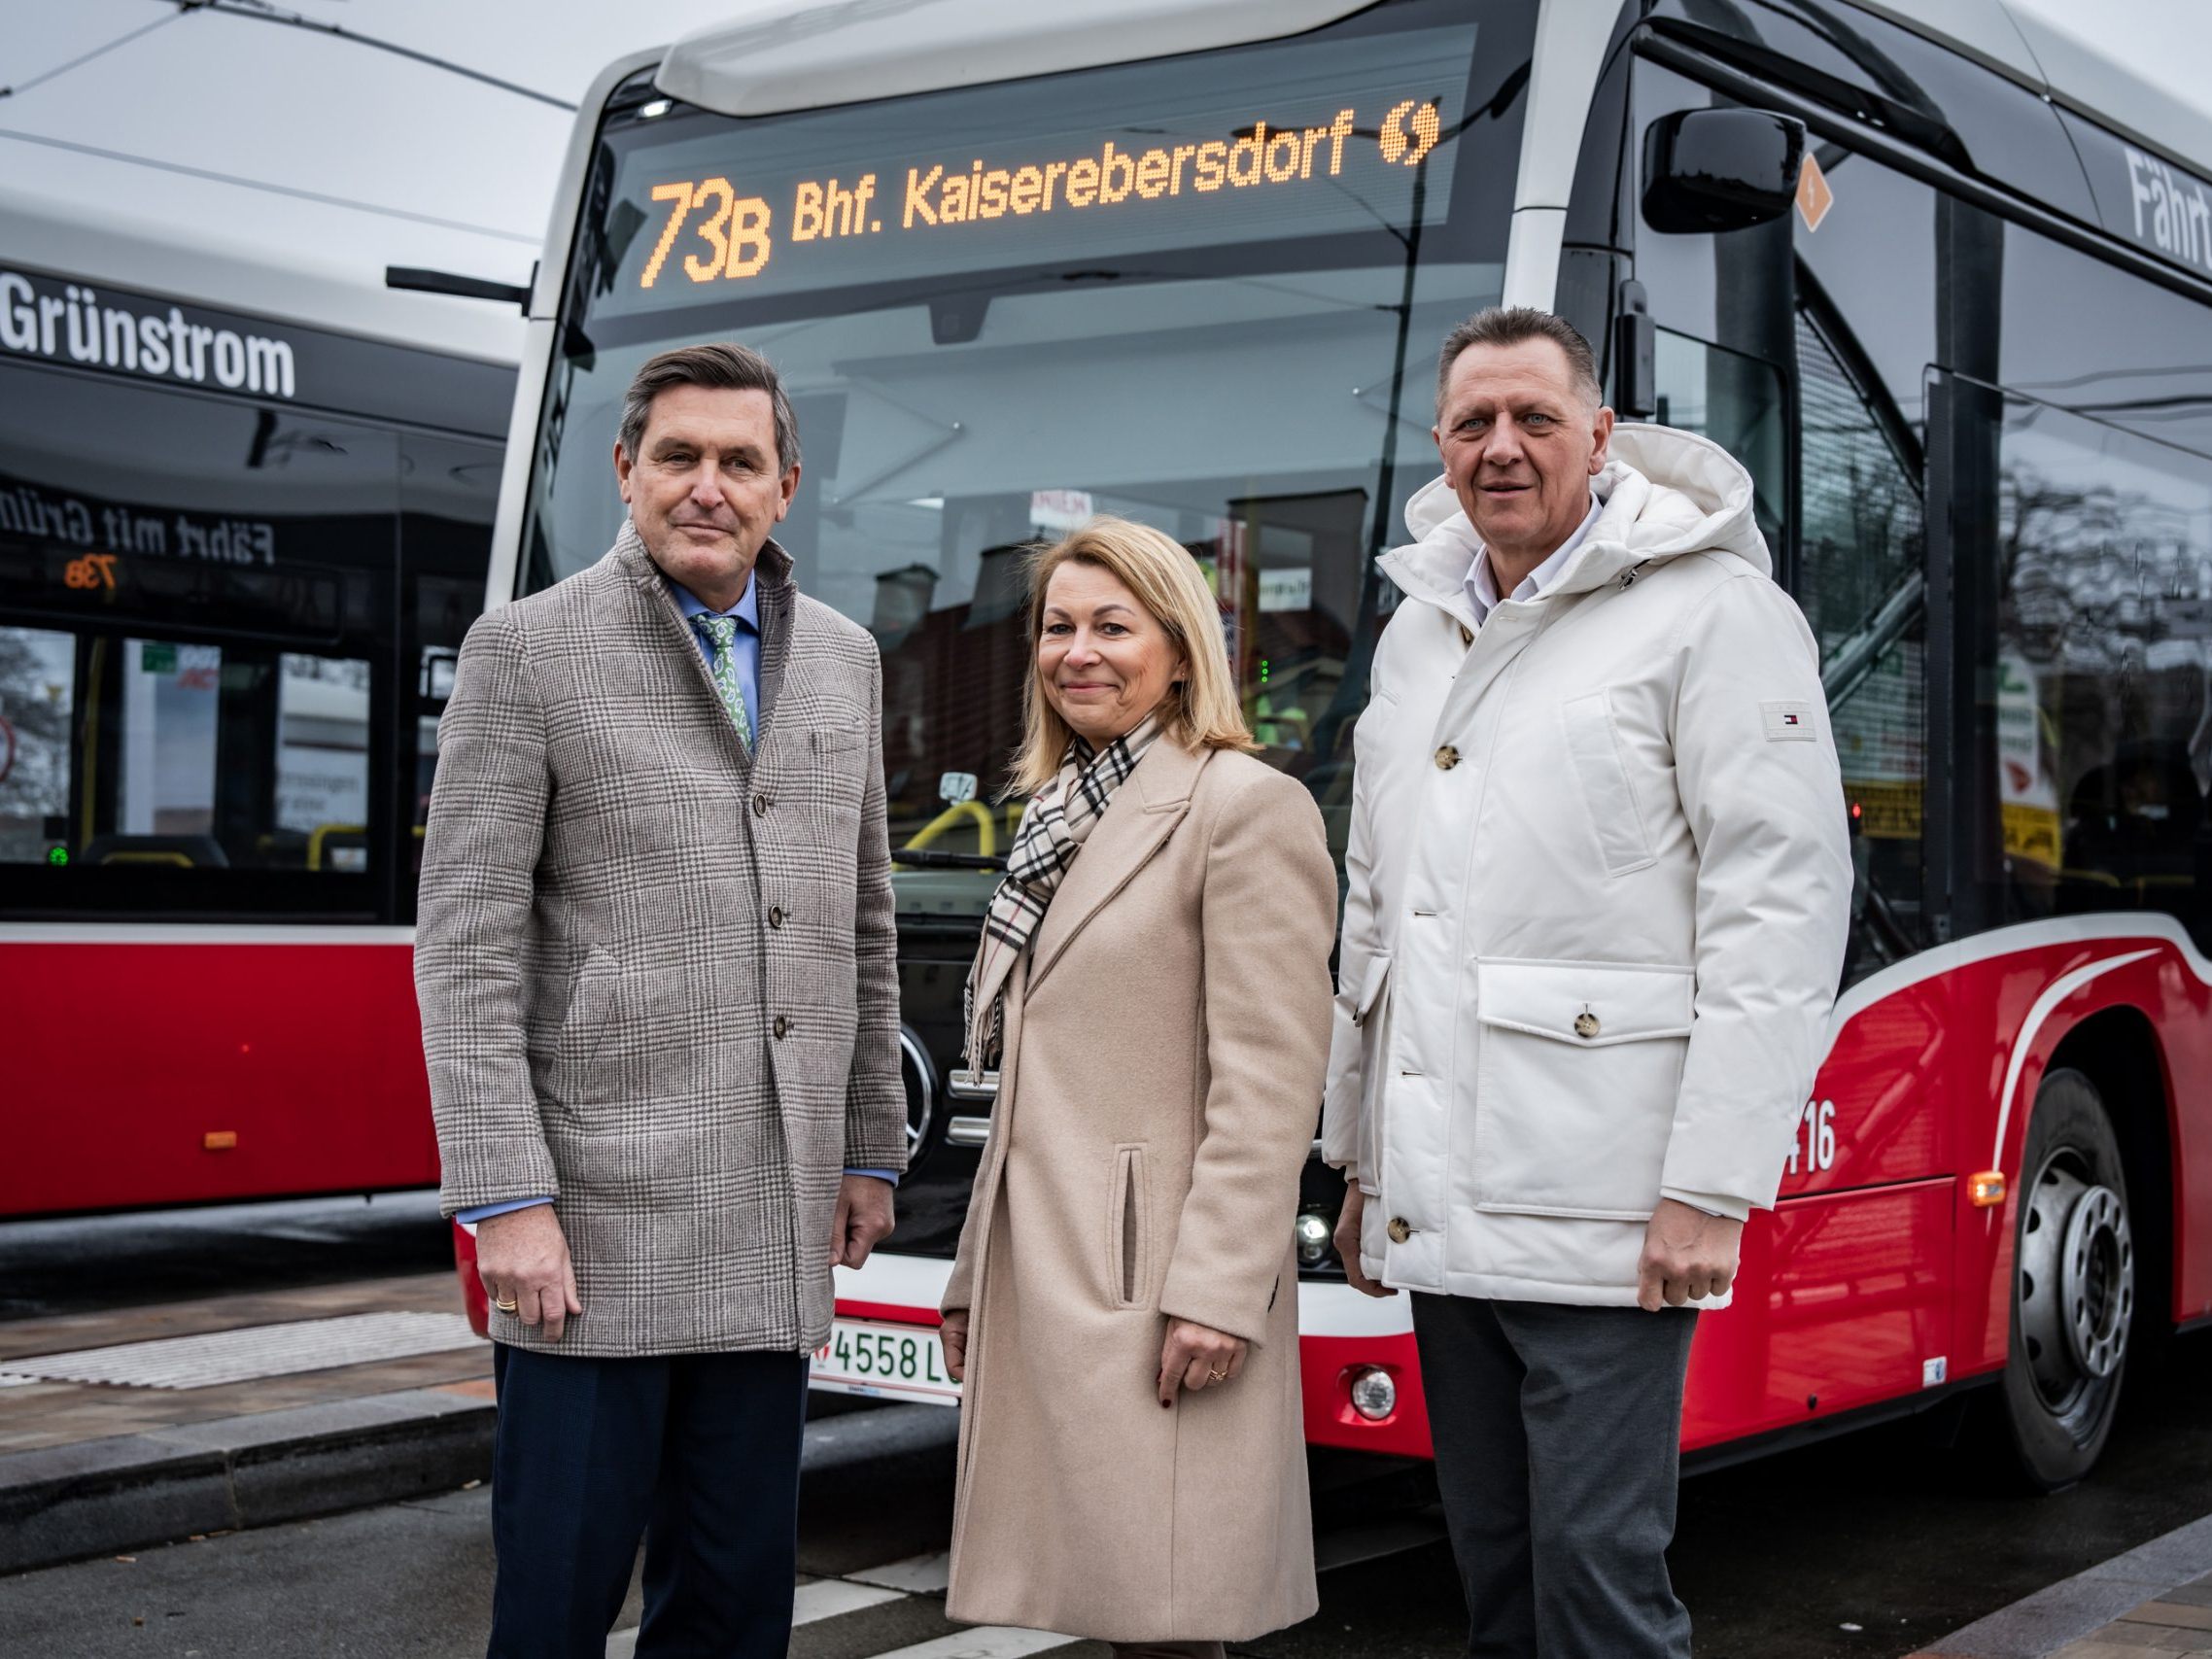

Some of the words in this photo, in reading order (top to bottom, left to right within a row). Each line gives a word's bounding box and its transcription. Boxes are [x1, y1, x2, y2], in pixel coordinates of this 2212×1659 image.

[639, 178, 772, 289] 73B
[792, 174, 881, 241] Bhf.
[903, 109, 1354, 228] Kaiserebersdorf
[2125, 147, 2212, 270] Fährt
[0, 272, 294, 397] Grünstrom
